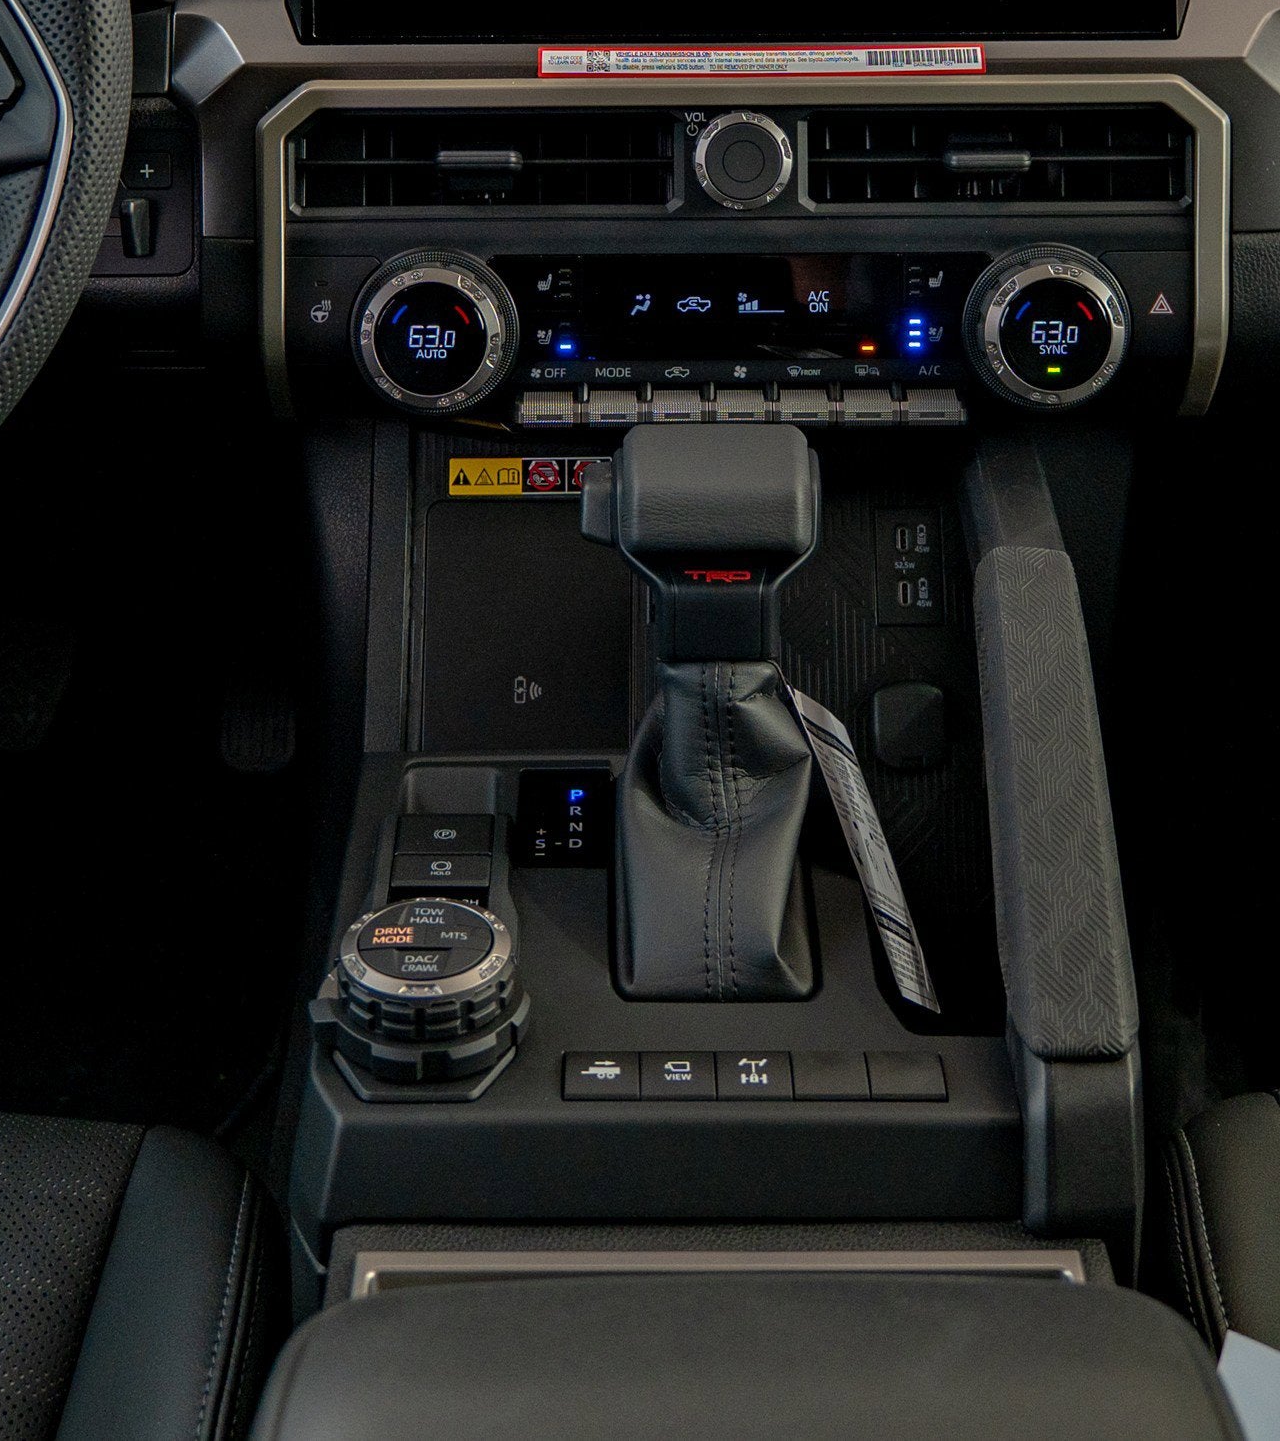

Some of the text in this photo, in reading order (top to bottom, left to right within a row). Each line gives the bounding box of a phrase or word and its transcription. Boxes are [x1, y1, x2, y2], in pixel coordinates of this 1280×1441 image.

[685, 112, 707, 122] VOL
[808, 290, 829, 303] A/C
[809, 302, 828, 313] ON
[409, 325, 455, 348] 63.0
[1031, 321, 1078, 343] 63.0
[416, 349, 447, 359] AUTO
[1039, 344, 1068, 355] SYNC
[544, 368, 567, 378] OFF
[595, 368, 631, 378] MODE
[800, 368, 821, 376] FRONT
[919, 365, 941, 376] A/C
[684, 569, 751, 582] TRD
[571, 789, 583, 800] P
[570, 806, 582, 816] R
[570, 822, 583, 832] N
[535, 838, 582, 849] S D
[414, 907, 444, 915] TOW
[410, 916, 445, 924] HAUL
[375, 926, 415, 935] DRIVE
[440, 931, 468, 940] MTS
[372, 936, 414, 944] MODE
[404, 954, 439, 963] DAC/
[401, 964, 439, 972] CRAWL
[664, 1072, 692, 1081] VIEW
